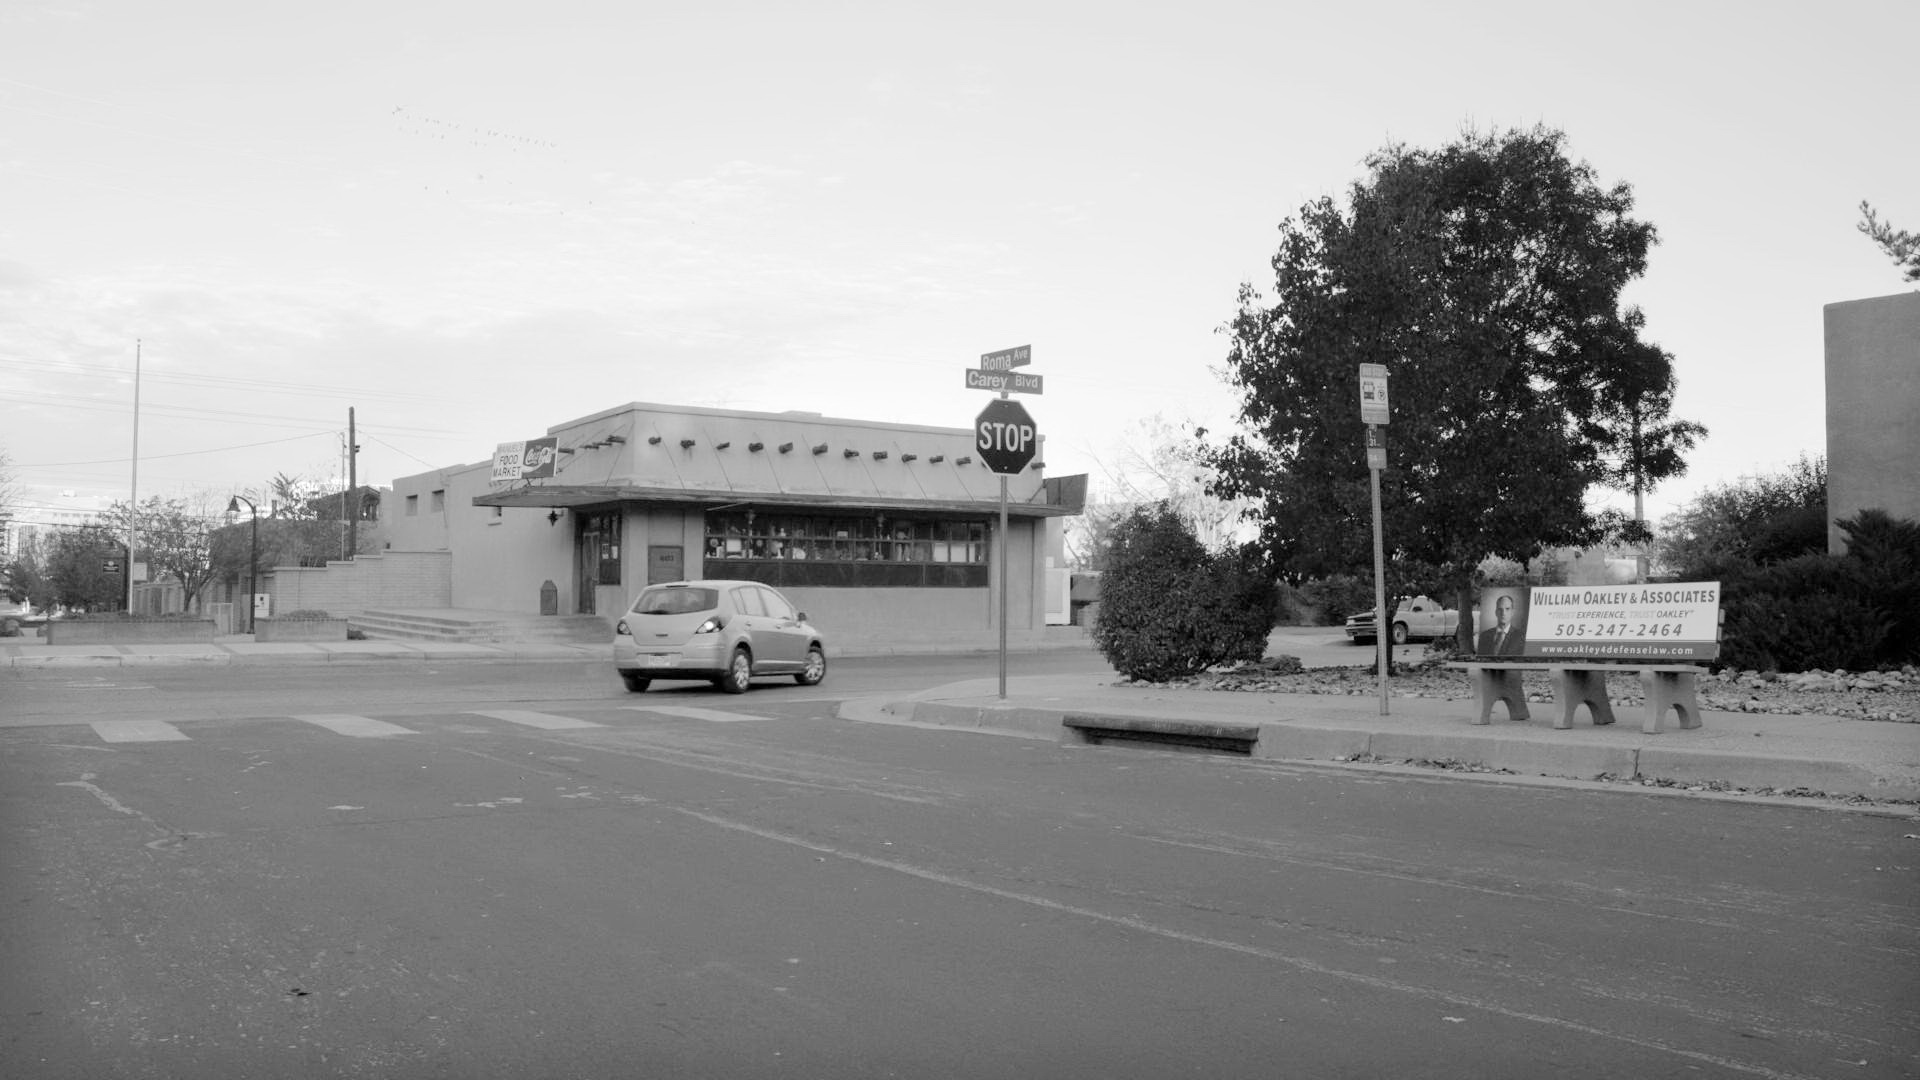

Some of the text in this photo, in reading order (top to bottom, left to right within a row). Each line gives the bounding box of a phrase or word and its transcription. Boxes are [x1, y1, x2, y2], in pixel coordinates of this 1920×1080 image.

[983, 349, 1028, 370] Roma Ave
[968, 371, 1038, 389] Carey Blvd
[979, 421, 1033, 452] STOP
[500, 455, 519, 465] FOOD
[493, 467, 521, 477] MARKET
[1534, 589, 1715, 606] WILLIAM OAKLEY & ASSOCIATES
[1555, 623, 1682, 637] 505-247-2464
[1541, 644, 1694, 656] www.oakley4defenselaw.com
